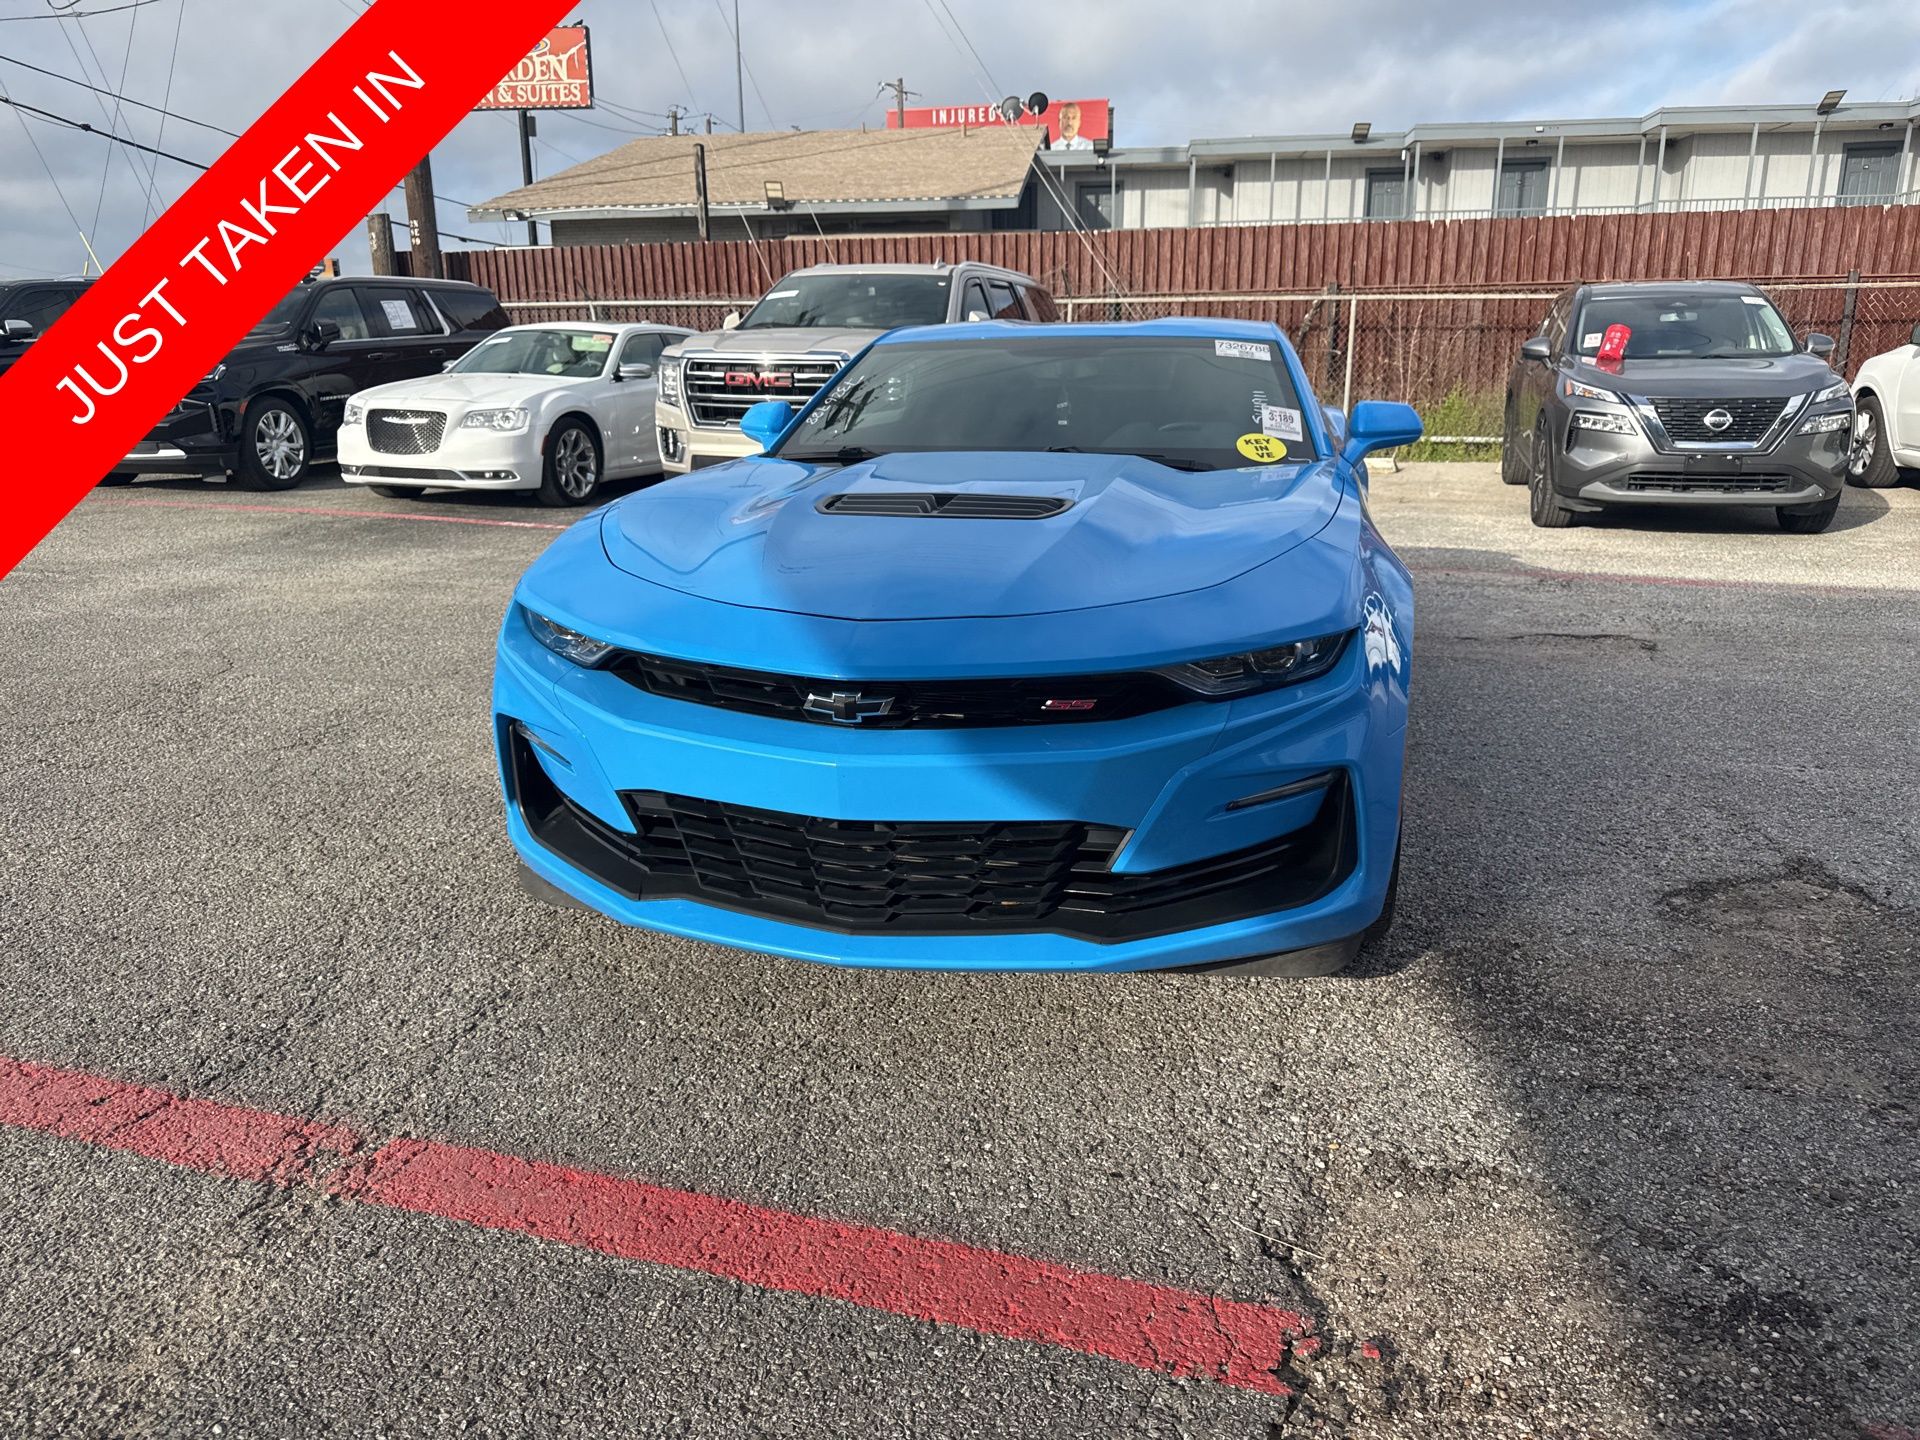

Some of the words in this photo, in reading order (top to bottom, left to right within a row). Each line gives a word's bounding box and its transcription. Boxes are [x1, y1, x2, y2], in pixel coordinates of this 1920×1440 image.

[497, 85, 515, 103] &
[516, 83, 581, 104] SUITES
[725, 372, 793, 391] GMC
[1041, 699, 1097, 710] SS
